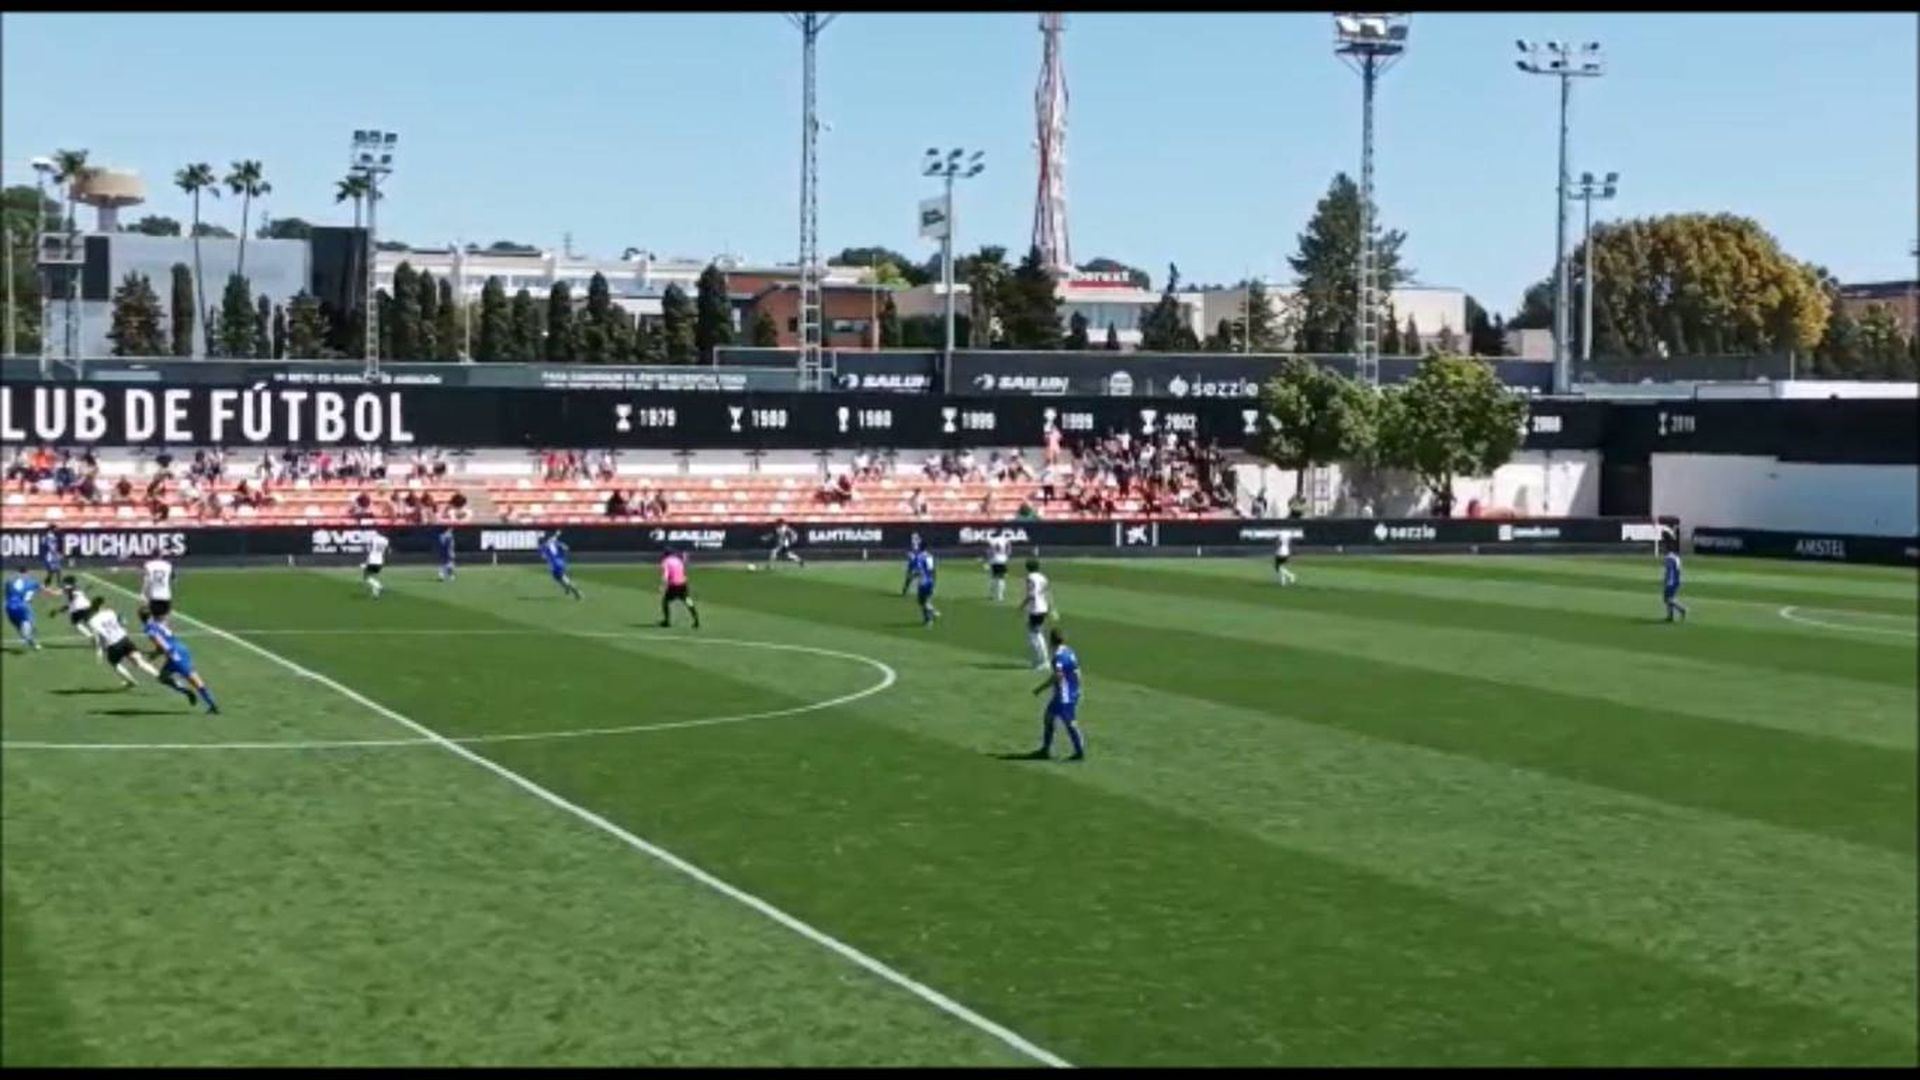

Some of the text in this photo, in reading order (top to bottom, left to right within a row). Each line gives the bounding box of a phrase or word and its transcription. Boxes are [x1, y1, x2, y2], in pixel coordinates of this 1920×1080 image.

[1191, 376, 1259, 397] sezzle
[124, 388, 192, 442] DE
[209, 382, 414, 443] FÚTBOL
[64, 533, 187, 557] PUCHADES
[480, 529, 539, 551] PUMA
[1795, 539, 1846, 558] AMSTEL
